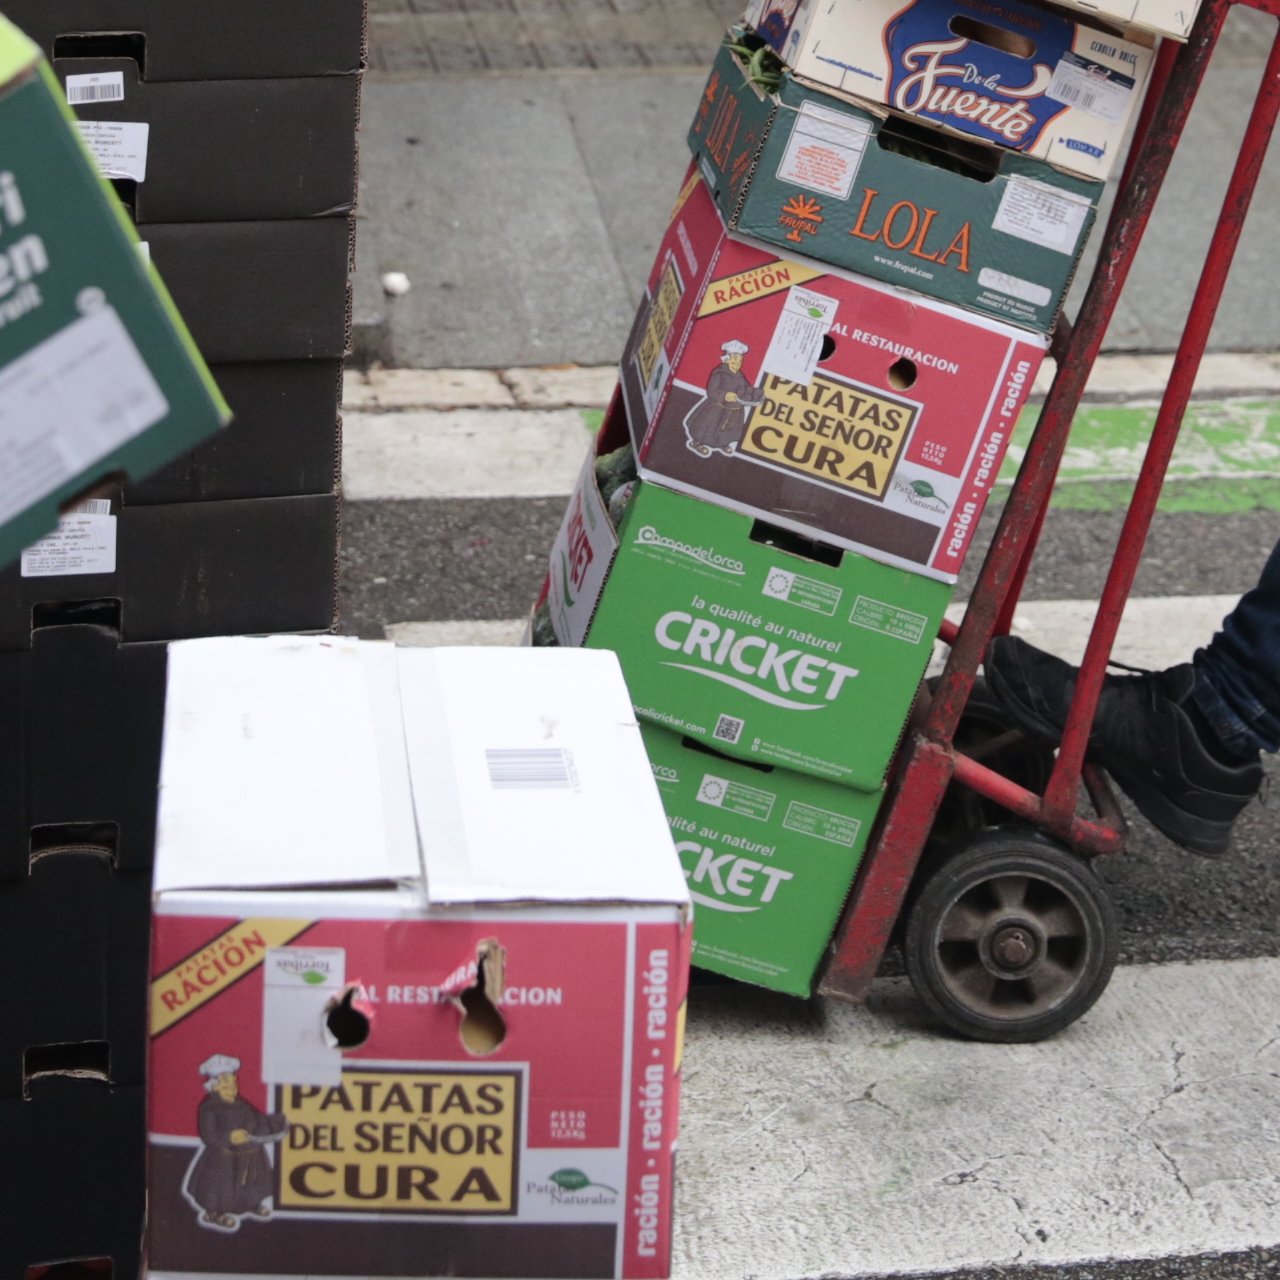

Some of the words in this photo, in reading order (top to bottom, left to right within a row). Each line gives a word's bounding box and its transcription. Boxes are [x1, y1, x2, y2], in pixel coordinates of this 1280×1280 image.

[895, 38, 1039, 141] Fuente
[963, 63, 979, 84] De
[780, 214, 817, 236] FRUPAL
[848, 188, 971, 273] LOLA
[728, 266, 773, 286] PATATAS
[873, 253, 934, 281] www.frupal.com
[851, 328, 959, 375] RESTAURACION
[770, 374, 903, 432] PATATAS
[760, 398, 794, 426] DEL
[799, 408, 893, 459] SEÑOR
[924, 440, 947, 453] PESO
[751, 425, 877, 490] CURA
[922, 446, 945, 459] NETO
[946, 501, 976, 558] ración
[974, 431, 1004, 488] ración
[1000, 360, 1031, 418] ración
[905, 495, 946, 515] Naturales
[691, 595, 706, 610] la
[708, 602, 762, 629] qualité
[764, 621, 784, 636] au
[786, 628, 842, 654] naturel
[654, 610, 860, 701] CRICKET
[632, 705, 707, 735] ocolicricket.com
[667, 816, 696, 834] alité
[699, 826, 718, 840] au
[721, 832, 776, 857] naturel
[675, 841, 794, 903] CKET
[161, 930, 266, 1011] RACION
[176, 934, 234, 978] PATATAS
[643, 949, 669, 1040] ración
[291, 1081, 504, 1115] PATATAS
[550, 1110, 586, 1119] PESO
[639, 1064, 665, 1151] ración
[289, 1123, 345, 1151] DEL
[354, 1116, 504, 1155] SEÑOR
[550, 1120, 586, 1129] NETO
[289, 1162, 502, 1202] CURA
[550, 1192, 616, 1205] Naturales
[634, 1174, 660, 1258] ración
